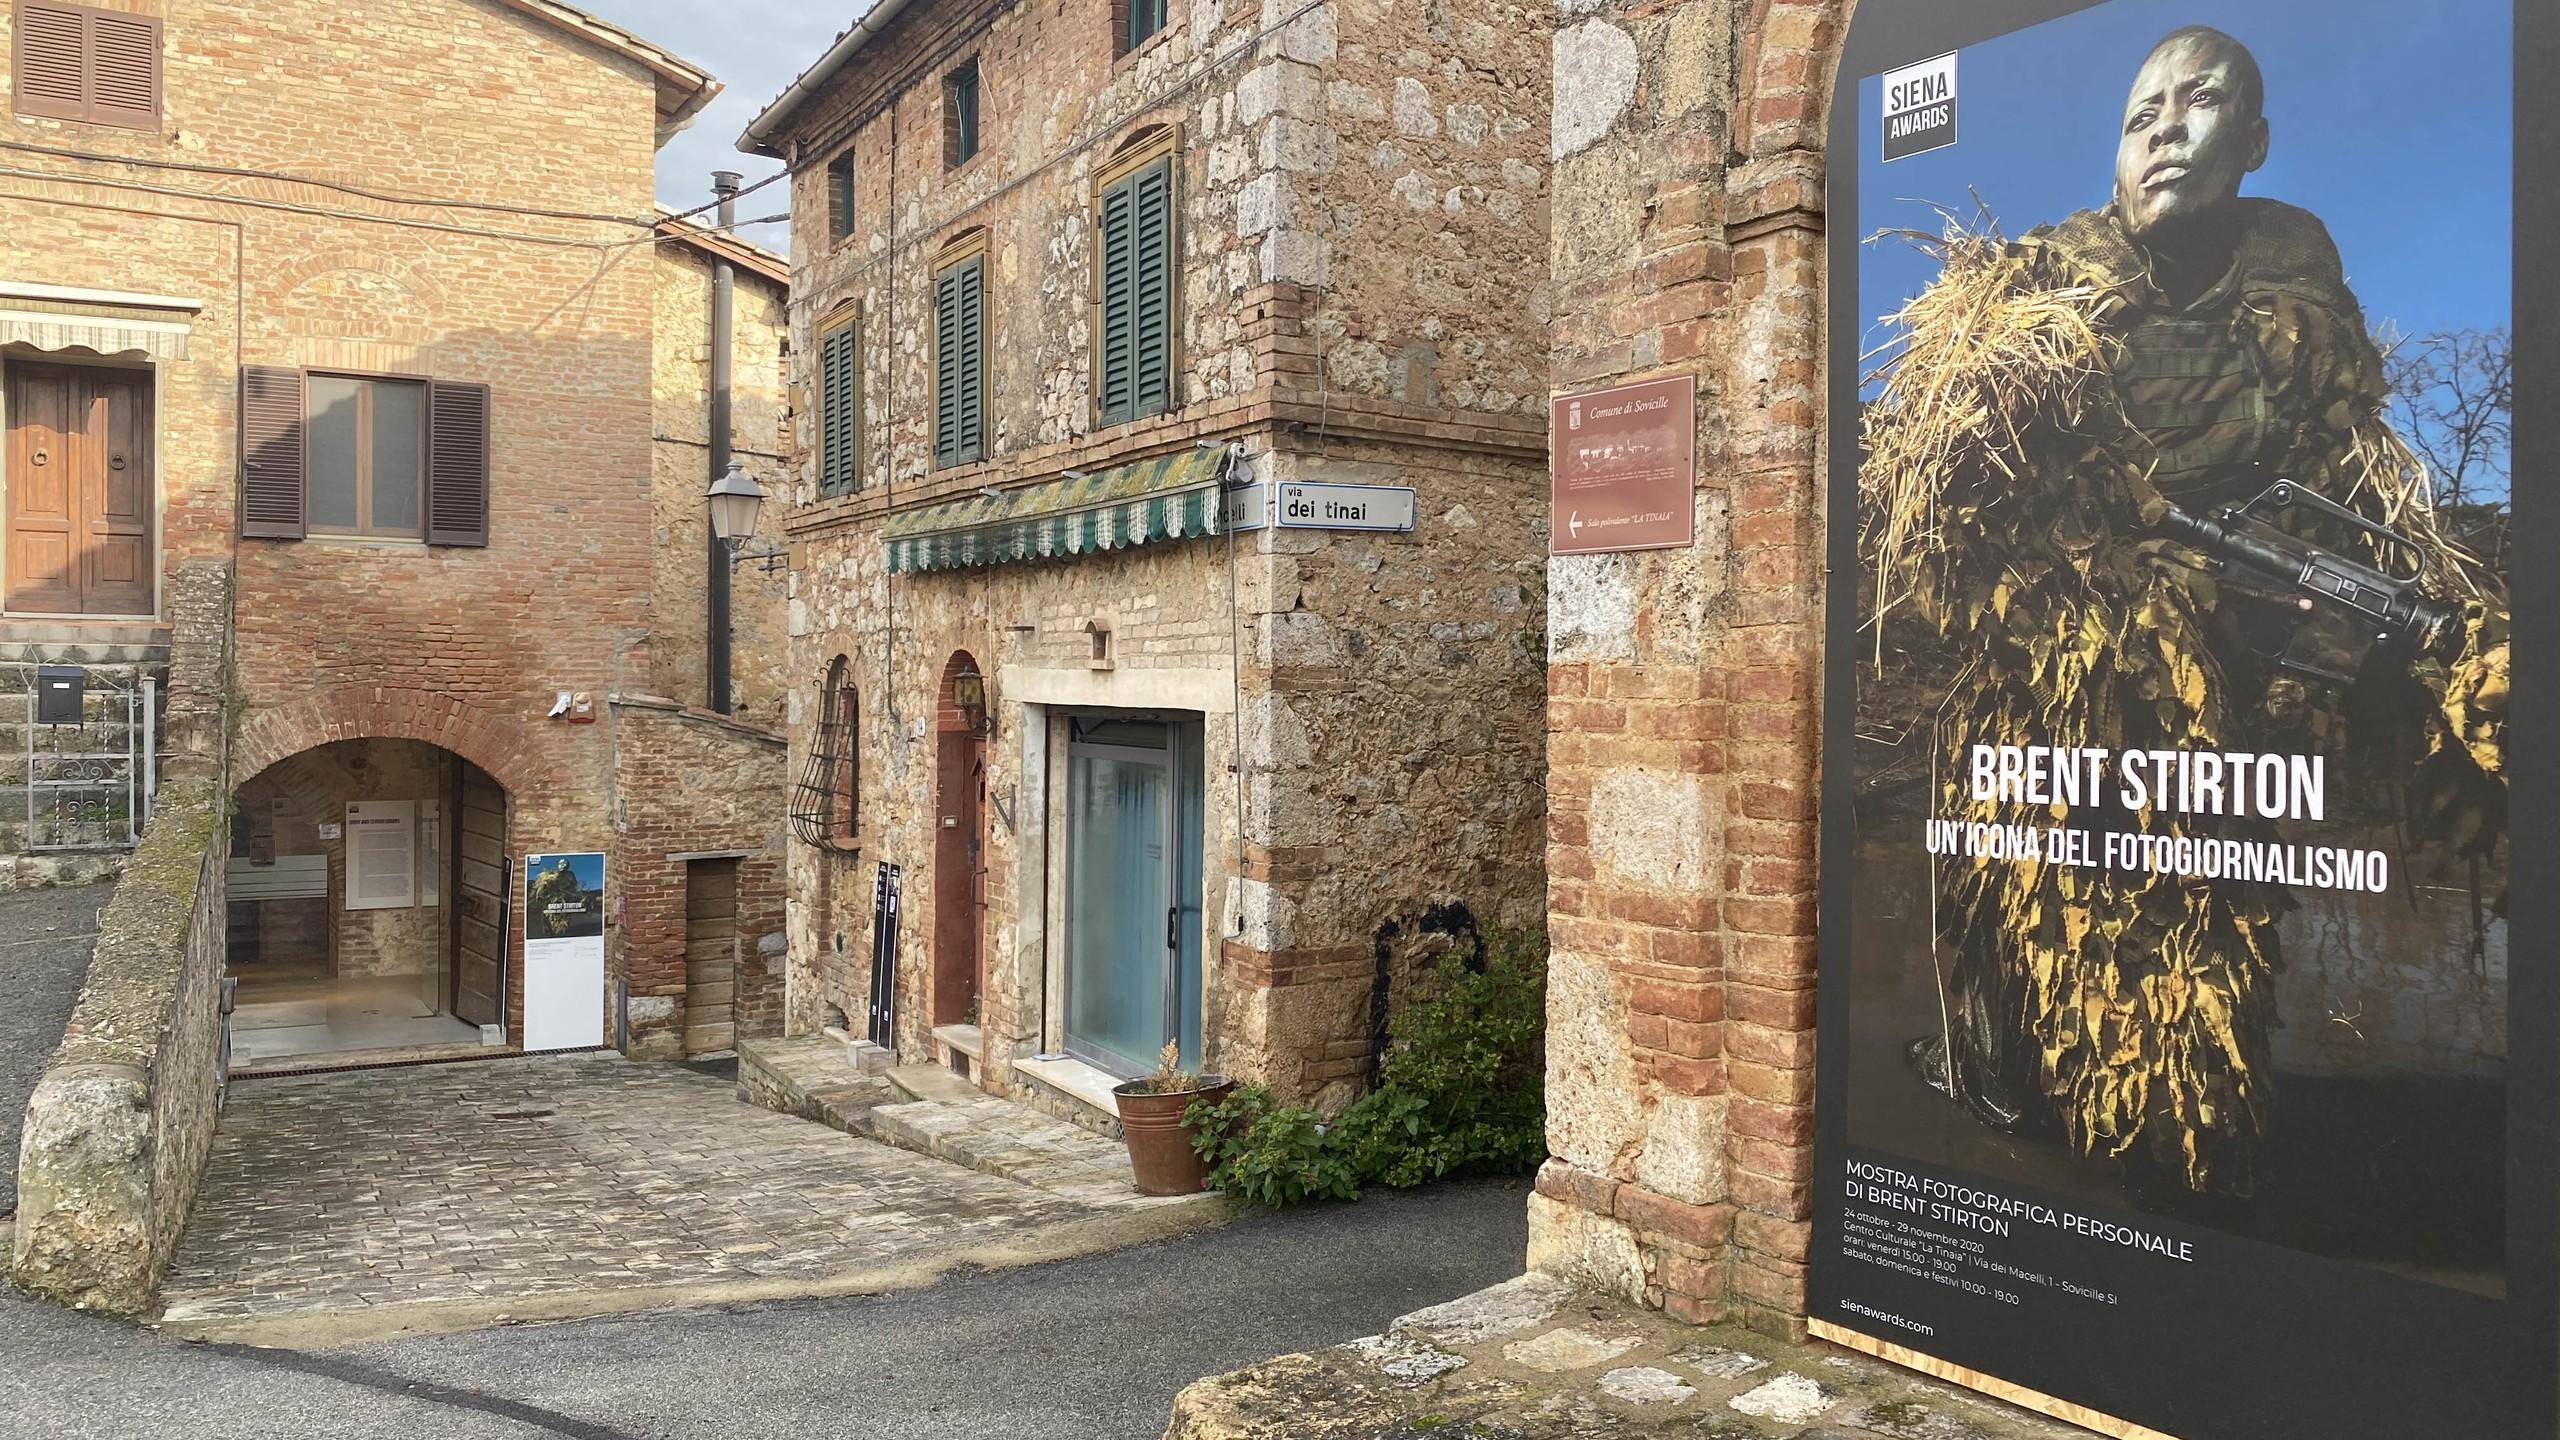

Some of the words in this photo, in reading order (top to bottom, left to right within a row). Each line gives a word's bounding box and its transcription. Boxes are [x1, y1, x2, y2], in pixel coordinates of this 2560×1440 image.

[1890, 71, 1948, 111] SIENA
[1890, 103, 1949, 140] AWARDS
[1590, 407, 1623, 419] Comune
[1623, 401, 1633, 414] di
[1634, 395, 1669, 413] Sovicille
[1287, 486, 1303, 497] via
[1288, 499, 1315, 518] dei
[1325, 500, 1367, 521] tinai
[1971, 743, 2110, 808] BRENT
[2120, 748, 2325, 821] STIRTON
[1925, 818, 2041, 863] UN'ICONA
[2047, 827, 2098, 868] DEL
[2104, 831, 2389, 894] FOTOGIORNALISMO
[1844, 1207, 1856, 1218] 24
[1856, 1211, 1890, 1229] ottobre
[1897, 1221, 1909, 1233] 29
[1910, 1227, 1959, 1247] novembre
[1959, 1238, 1985, 1254] 2020
[1846, 1180, 1863, 1199] DI
[1868, 1186, 1927, 1215] BRENT
[1931, 1202, 2009, 1238] STIRTON
[1846, 1159, 1919, 1192] MOSTRA
[1923, 1178, 2058, 1228] FOTOGRAFICA
[2063, 1212, 2193, 1262] PERSONALE
[1843, 1220, 1874, 1237] Centro
[1875, 1228, 1917, 1249] Culturale
[1918, 1240, 1933, 1253] "La
[1935, 1245, 1967, 1262] Tinaia"
[1973, 1256, 1989, 1269] Via
[1990, 1261, 2007, 1275] dei
[2009, 1266, 2047, 1287] Macelli,
[2062, 1280, 2105, 1302] Sovicille
[2107, 1293, 2118, 1305] SI
[1843, 1247, 1875, 1265] sabato,
[1875, 1255, 1922, 1277] domenica
[1923, 1271, 1930, 1279] e
[1931, 1271, 1959, 1288] festivi
[1960, 1279, 1986, 1296] 10.00
[1994, 1289, 2020, 1305] 19.00
[1902, 1250, 1925, 1265] 15.00
[1933, 1258, 1957, 1273] 19.00
[1840, 1298, 1934, 1337] sienawards.com
